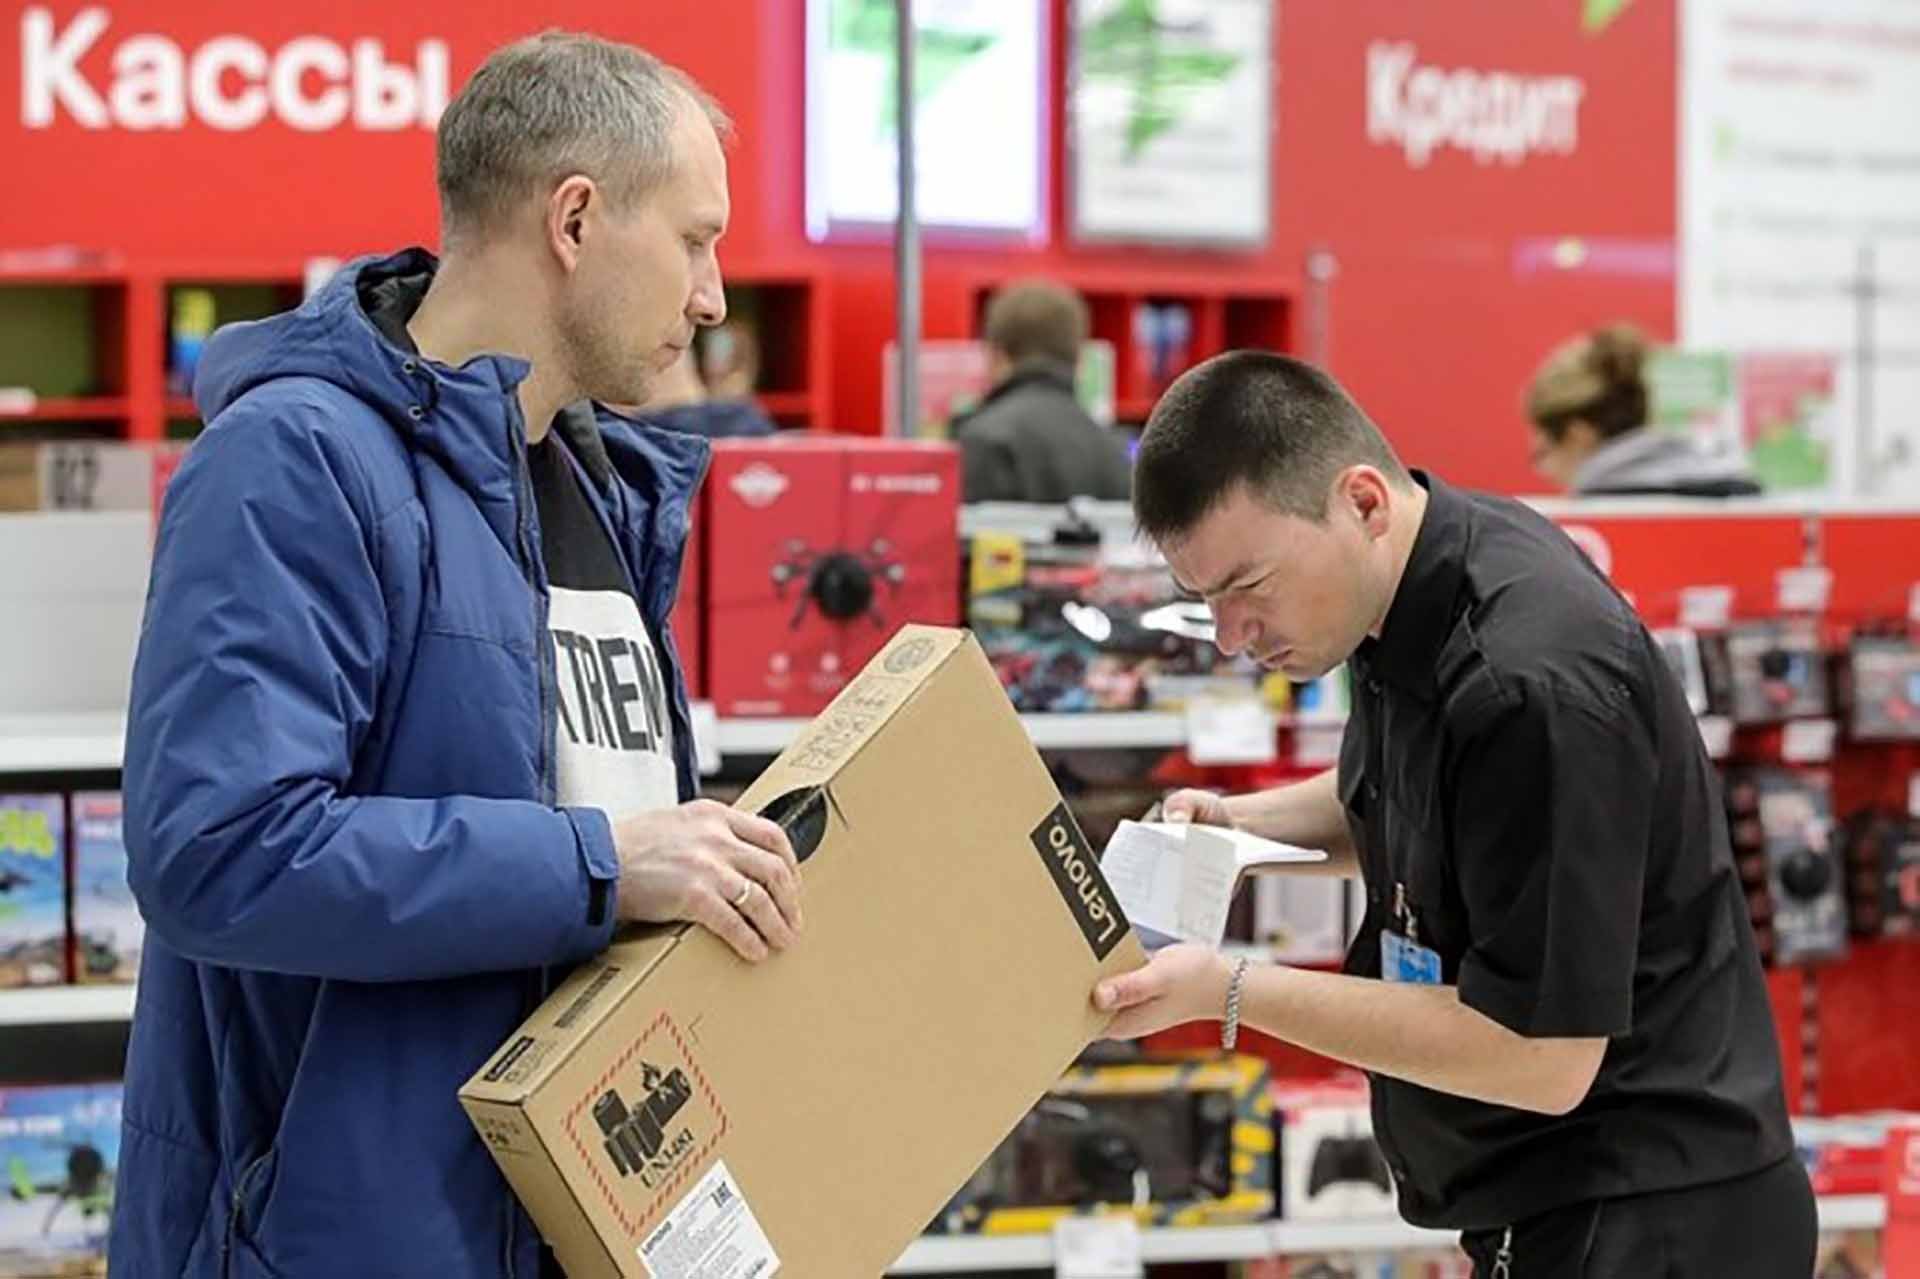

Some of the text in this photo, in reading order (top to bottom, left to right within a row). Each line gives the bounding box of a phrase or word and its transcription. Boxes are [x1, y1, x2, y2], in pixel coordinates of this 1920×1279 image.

[21, 7, 450, 131] Кассы
[1367, 42, 1583, 167] Кредит
[1050, 825, 1117, 943] Lenovo
